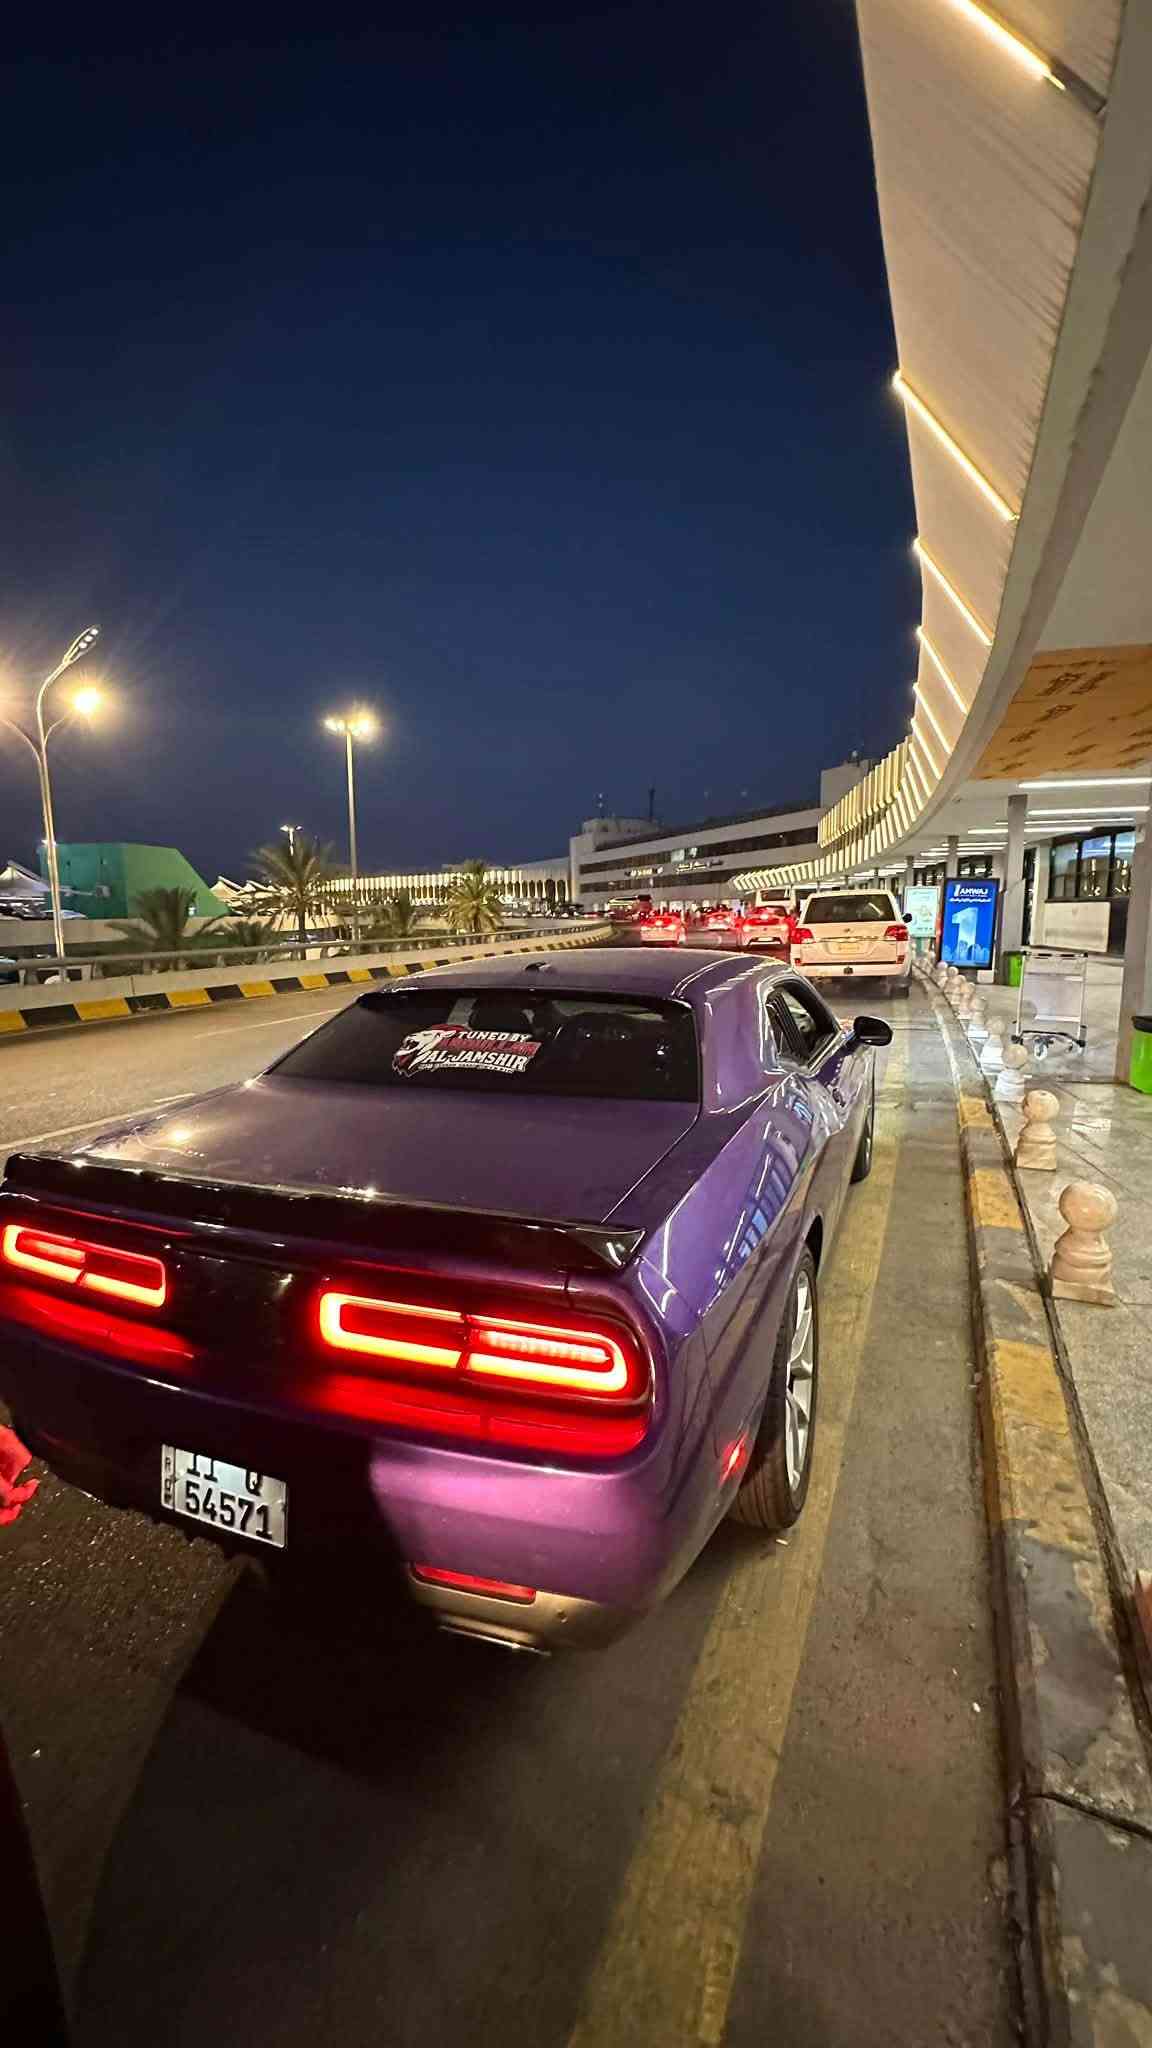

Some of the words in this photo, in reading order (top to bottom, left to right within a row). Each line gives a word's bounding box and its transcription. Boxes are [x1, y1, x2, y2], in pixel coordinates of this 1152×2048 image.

[457, 1030, 509, 1041] TUNED
[508, 1032, 533, 1043] BY
[424, 1050, 529, 1071] AL-JAMSHIR
[186, 1480, 273, 1540] 54571
